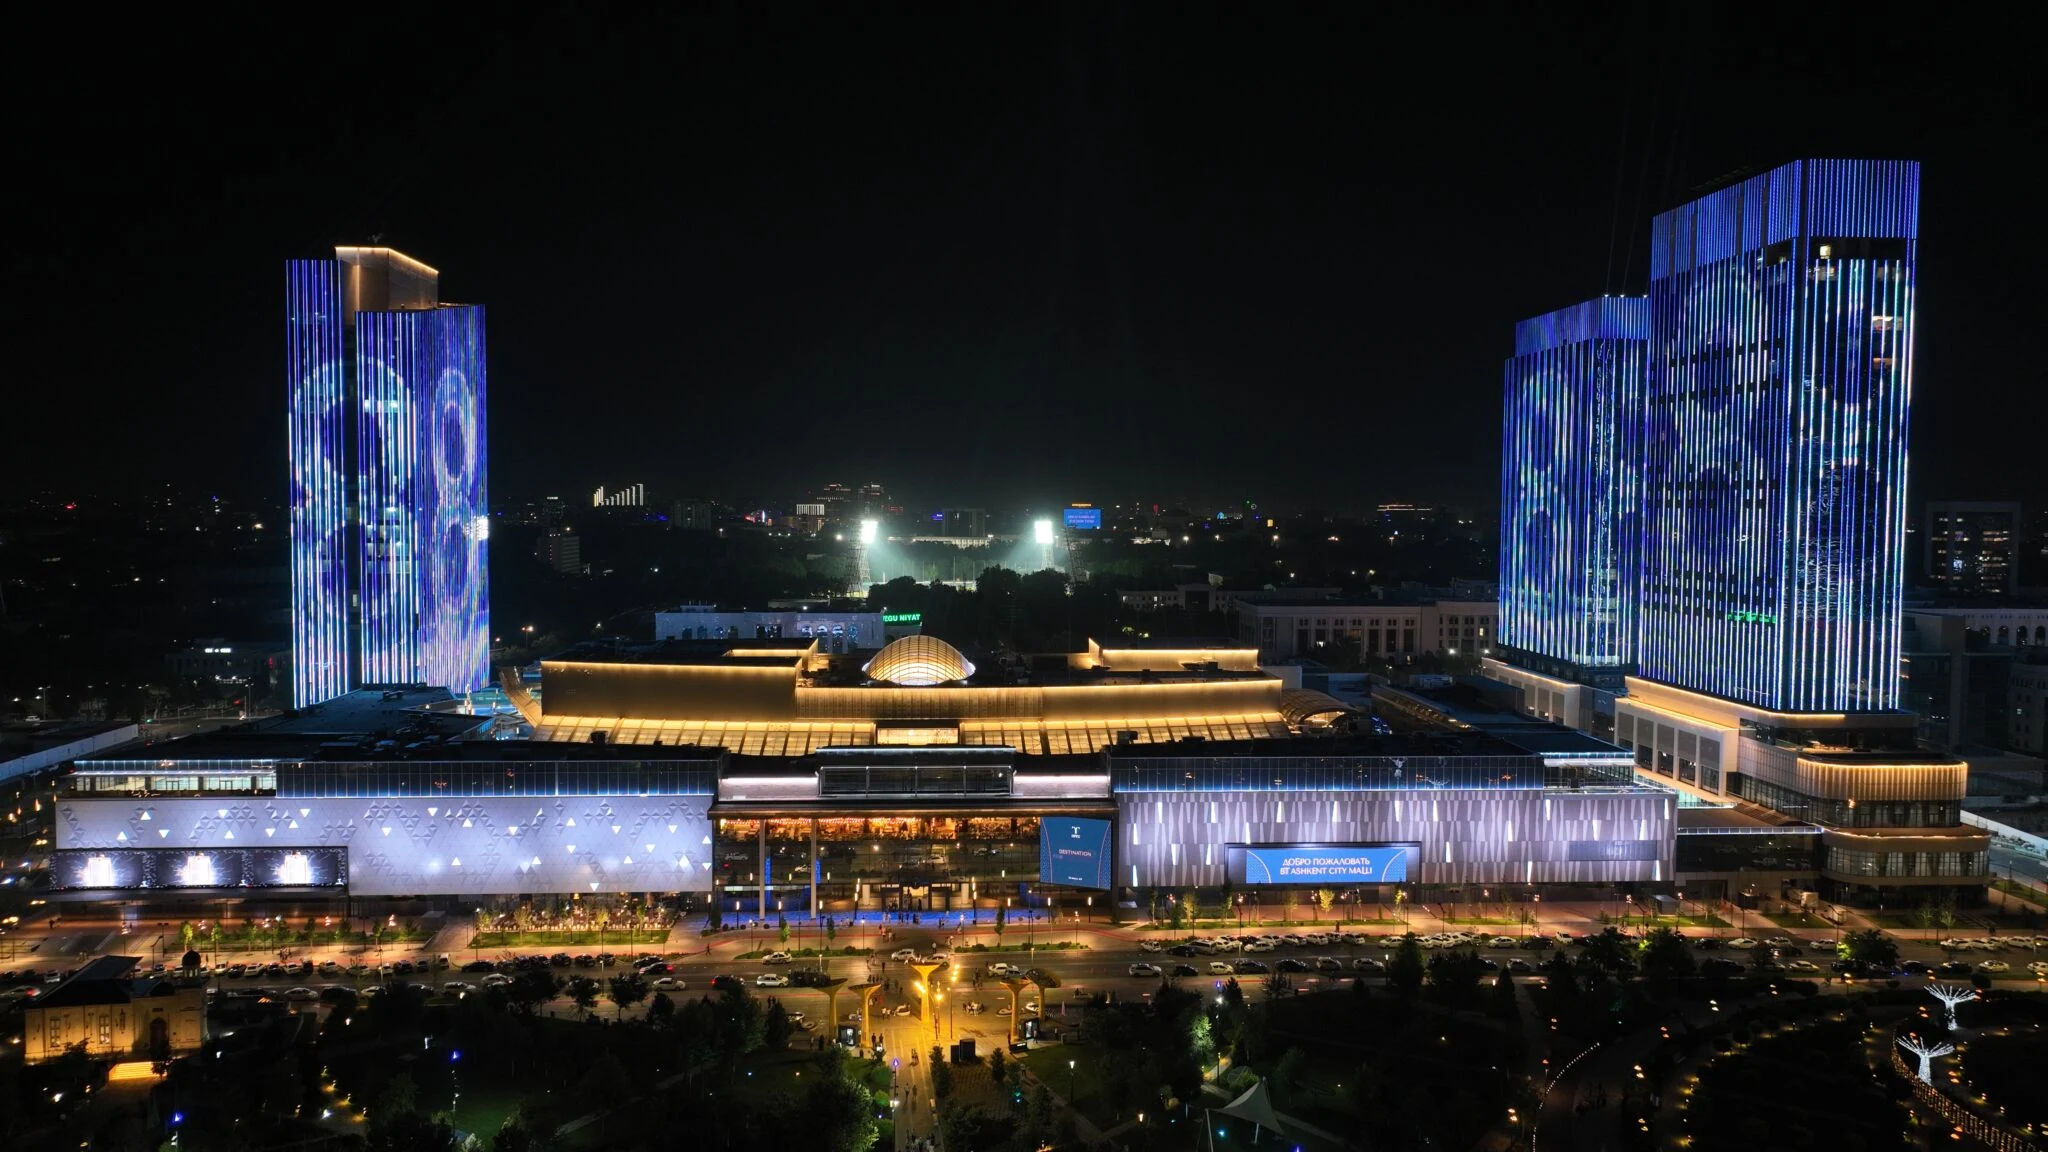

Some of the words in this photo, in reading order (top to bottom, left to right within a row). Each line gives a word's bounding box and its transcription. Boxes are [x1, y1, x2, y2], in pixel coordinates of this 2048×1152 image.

[899, 613, 921, 621] NIYAT
[1058, 849, 1092, 857] DESTINATION
[1282, 857, 1311, 867] ДОБРО
[1312, 857, 1370, 867] ПОЖАЛОВАТЬ
[1328, 867, 1347, 875] CITY
